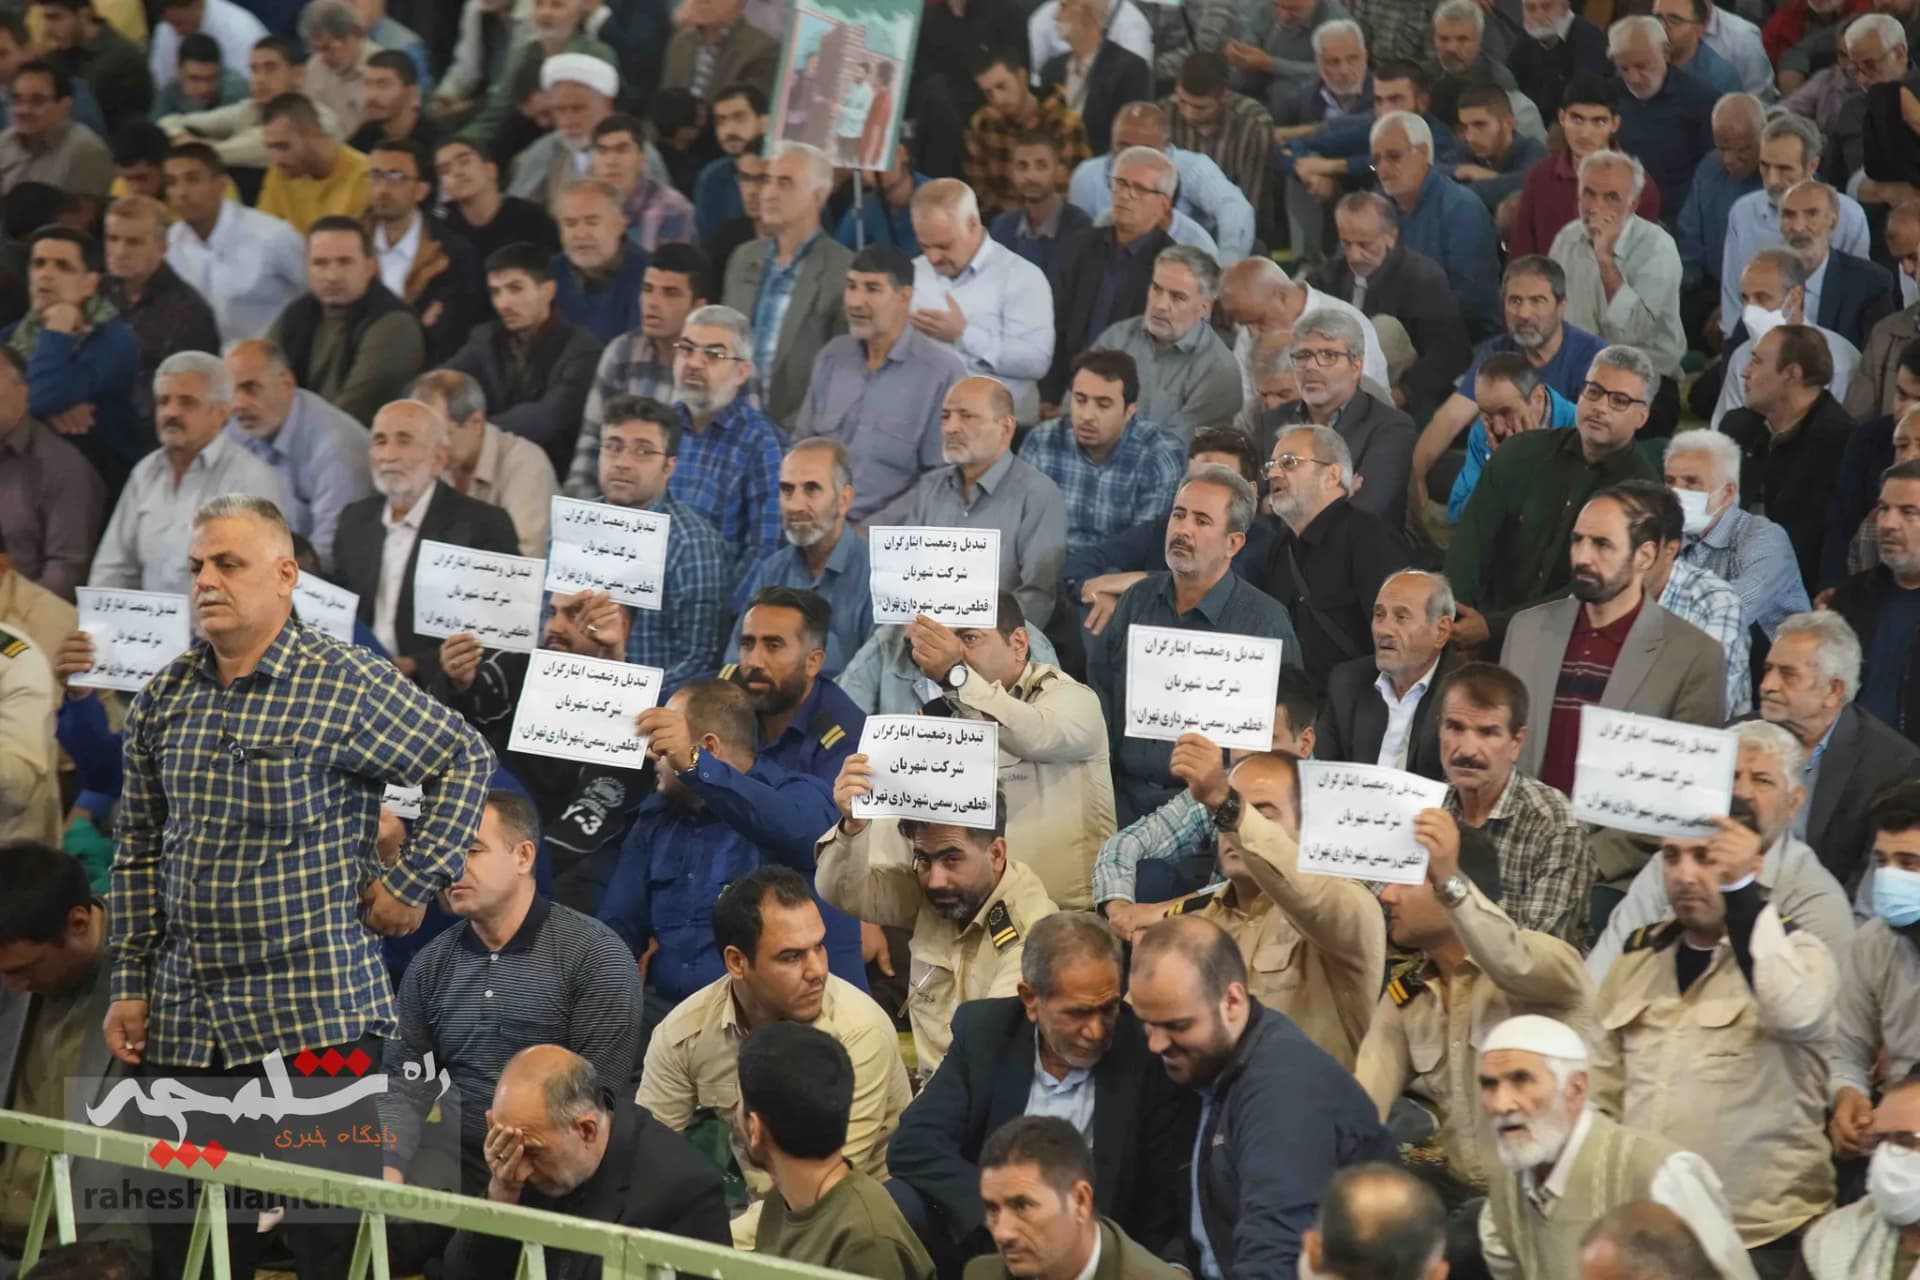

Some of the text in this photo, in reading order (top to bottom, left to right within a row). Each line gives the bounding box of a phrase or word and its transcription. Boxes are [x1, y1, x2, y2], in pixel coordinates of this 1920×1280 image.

[924, 536, 957, 552] وضعیت
[959, 536, 987, 552] تبدیل
[936, 567, 968, 583] شرکت
[587, 667, 618, 687] وضعیت
[621, 673, 648, 690] تبدیل
[591, 700, 622, 717] شرکت
[917, 728, 952, 745] وضعیت
[955, 728, 984, 746] تبدیل
[890, 757, 965, 778] شرکت شهربان
